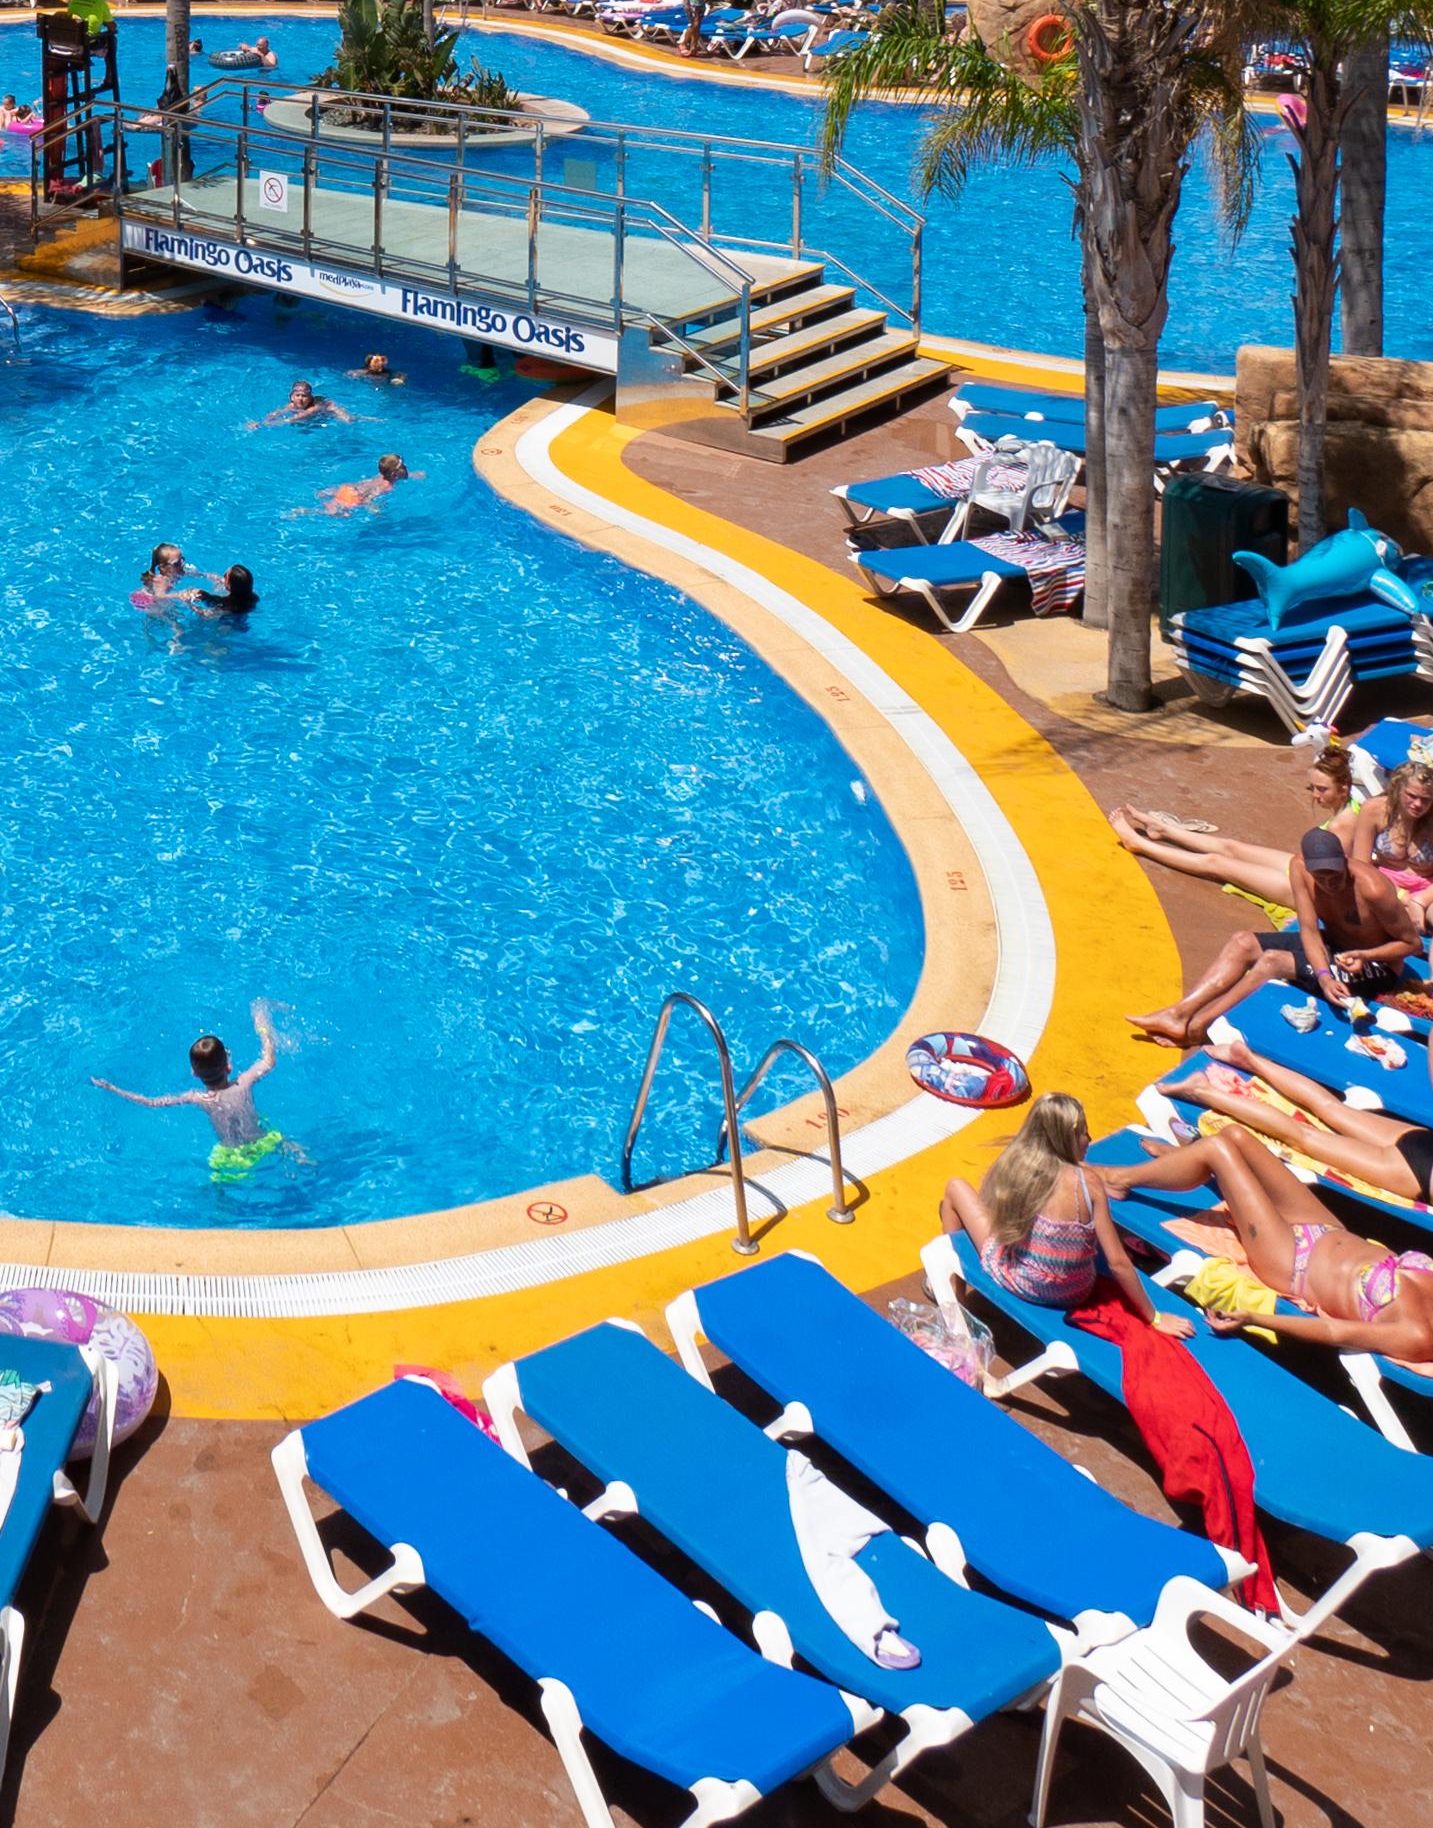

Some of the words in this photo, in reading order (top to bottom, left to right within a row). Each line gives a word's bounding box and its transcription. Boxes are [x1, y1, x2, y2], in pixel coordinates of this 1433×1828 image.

[144, 228, 231, 267] Flamingo
[234, 249, 293, 283] Oasis
[401, 288, 507, 334] Flamingo
[512, 315, 585, 353] Oasis
